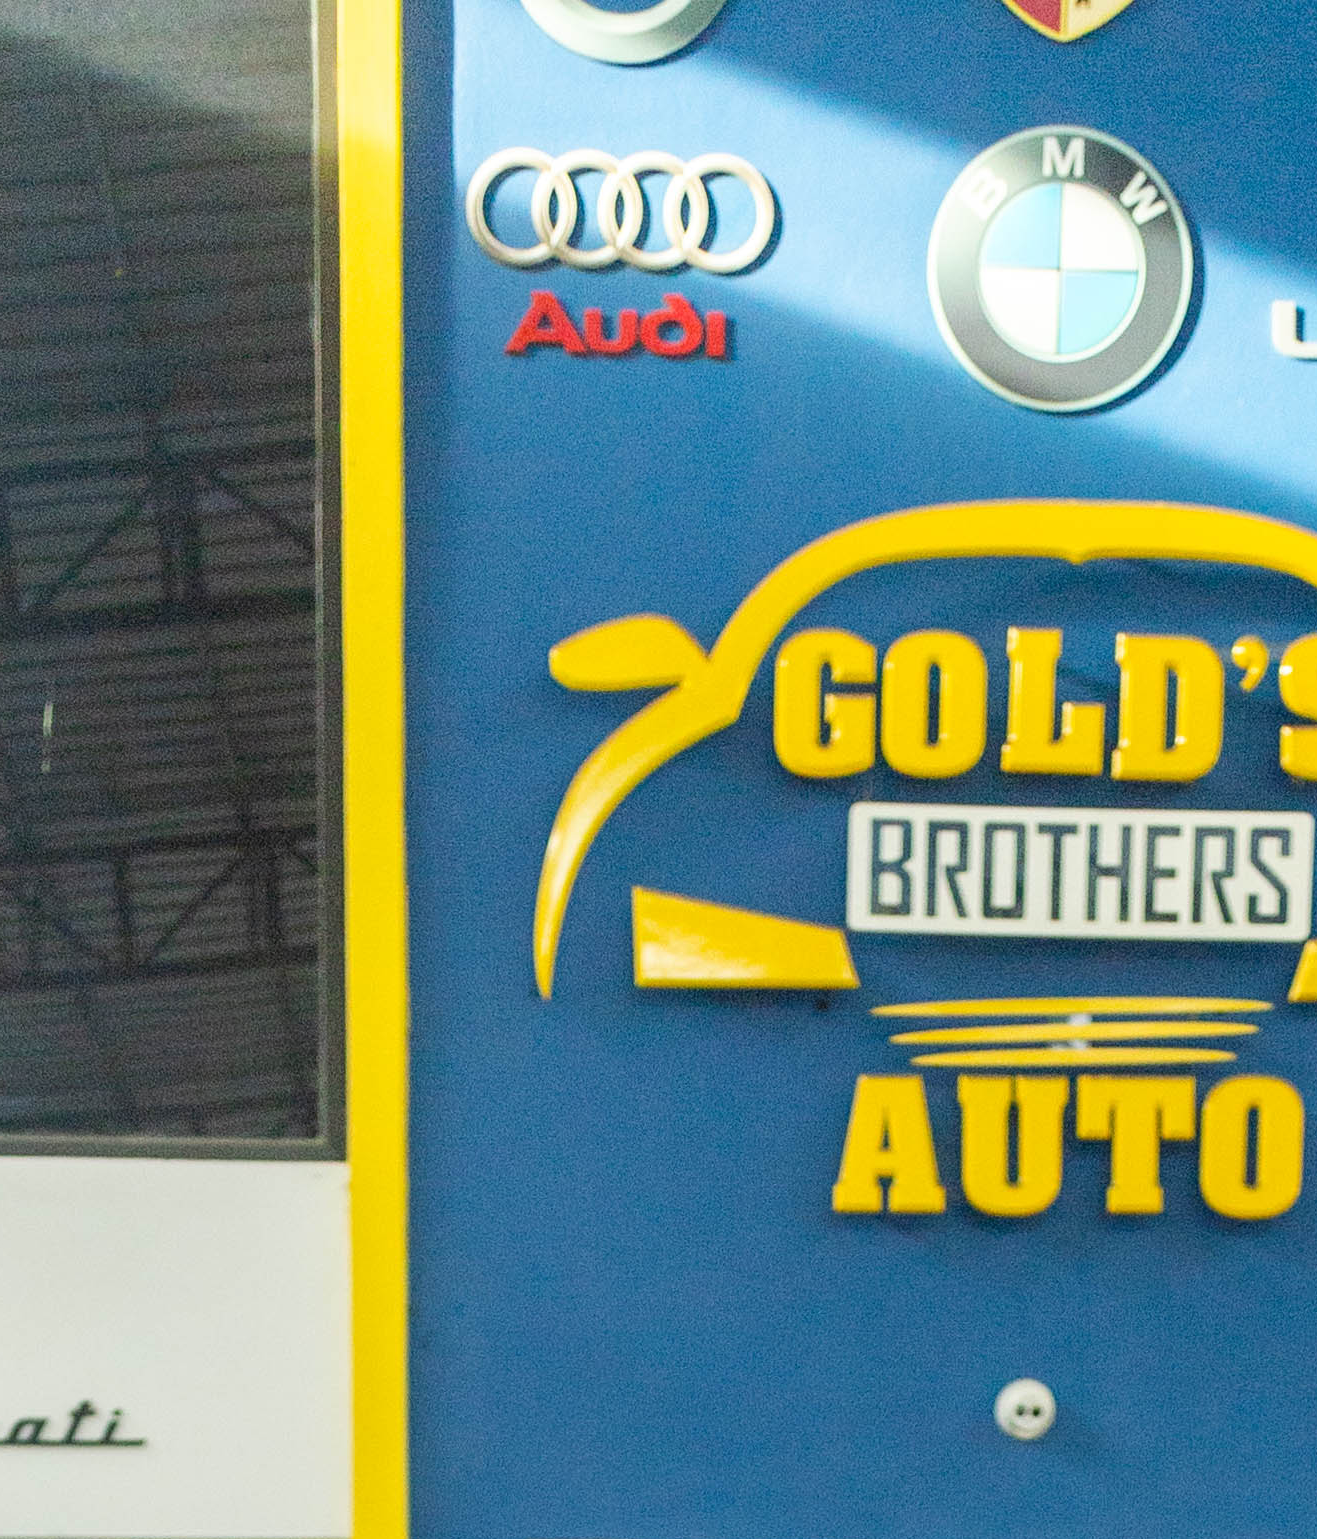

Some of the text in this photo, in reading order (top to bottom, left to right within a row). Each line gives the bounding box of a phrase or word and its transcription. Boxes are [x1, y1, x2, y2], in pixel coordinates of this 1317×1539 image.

[958, 136, 1167, 224] BMW
[504, 291, 726, 361] Audi
[870, 816, 1293, 926] BROTHERS
[831, 1074, 1306, 1219] AUTO
